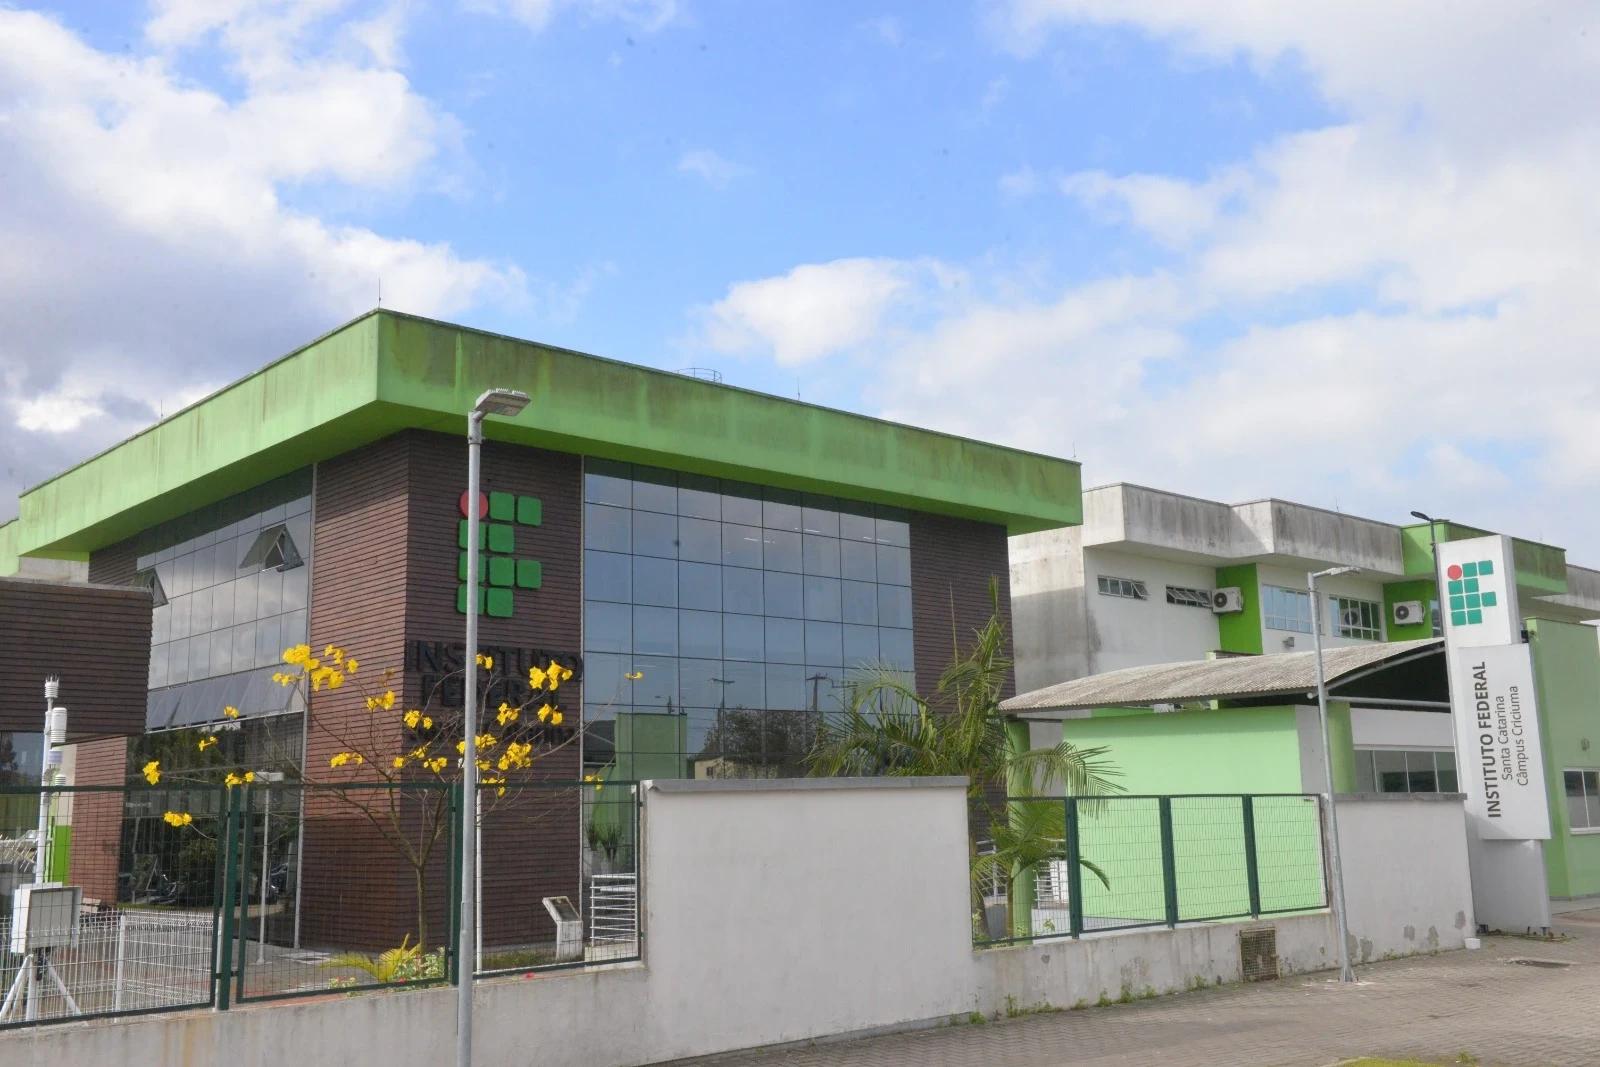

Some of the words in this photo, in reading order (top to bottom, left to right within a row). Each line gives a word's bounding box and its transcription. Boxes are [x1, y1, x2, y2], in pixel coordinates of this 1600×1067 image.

[1472, 661, 1492, 729] FEDERAL
[1495, 694, 1509, 745] Catarina
[1480, 733, 1502, 818] INSTITUTO
[1500, 747, 1514, 782] Santa
[1515, 738, 1530, 787] Câmpus
